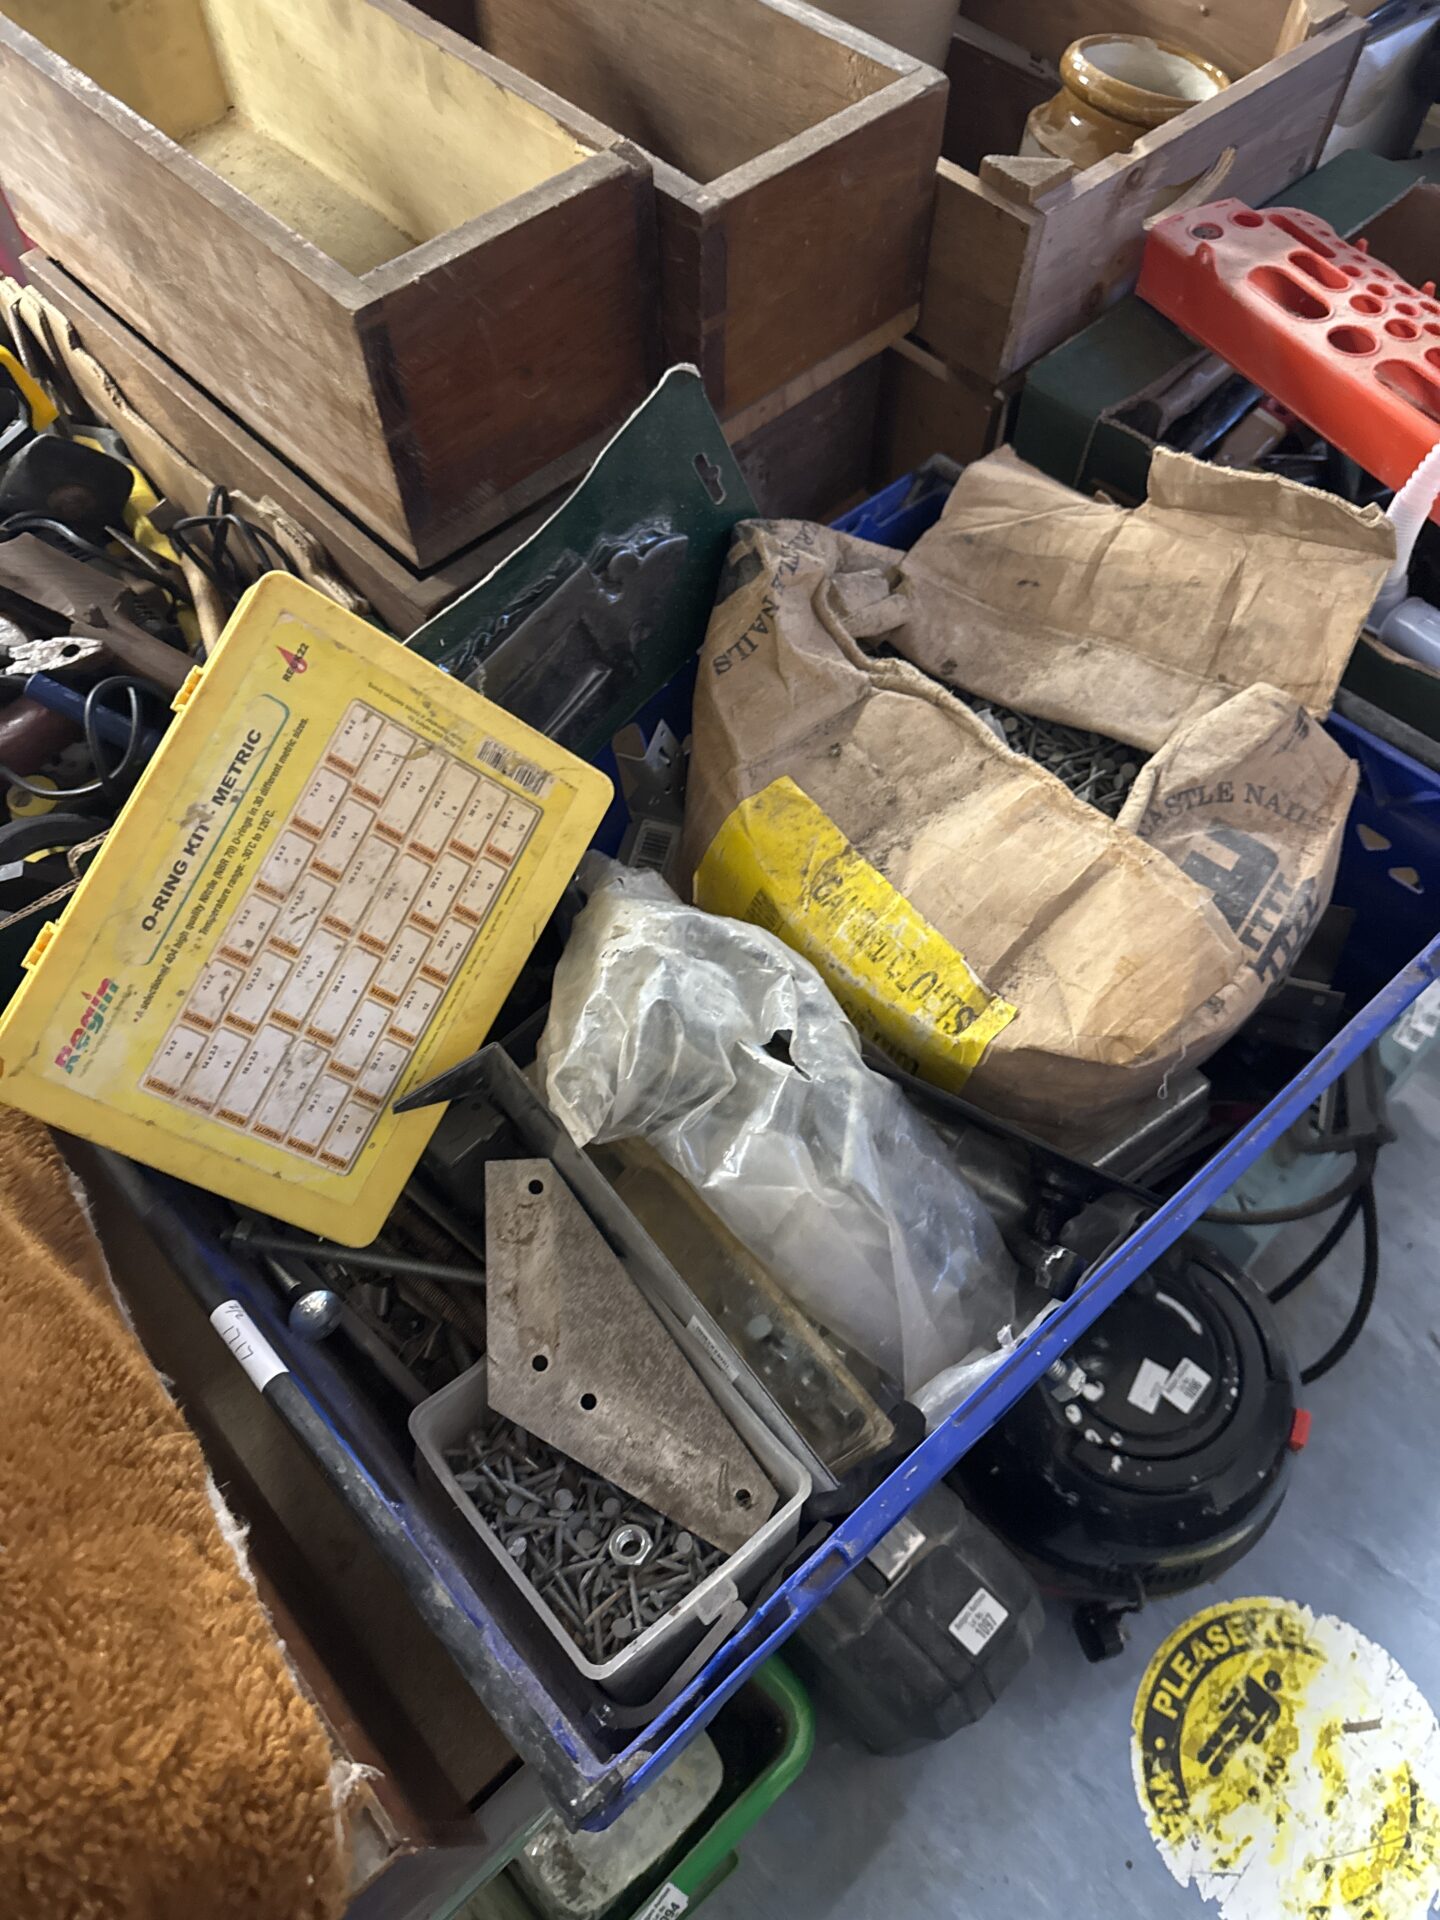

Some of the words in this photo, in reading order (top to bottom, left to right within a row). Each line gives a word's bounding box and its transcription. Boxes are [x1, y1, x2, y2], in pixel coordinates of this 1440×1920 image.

[711, 595, 780, 676] NAILS
[276, 737, 297, 764] metric
[258, 762, 283, 797] different
[247, 805, 259, 816] in
[252, 794, 265, 808] 30
[139, 857, 189, 933] O-RING
[182, 820, 210, 857] KIT
[210, 727, 263, 807] METRIC
[198, 886, 232, 937] Temperature
[226, 862, 246, 889] range:
[251, 831, 262, 842] to
[198, 877, 218, 904] Nitrile
[183, 902, 205, 932] quality
[172, 929, 190, 950] high
[164, 947, 179, 965] 404
[51, 973, 123, 1076] Regin
[223, 1325, 254, 1361] 1717
[975, 1612, 998, 1639] 1097
[1151, 1615, 1248, 1721] PLEASE
